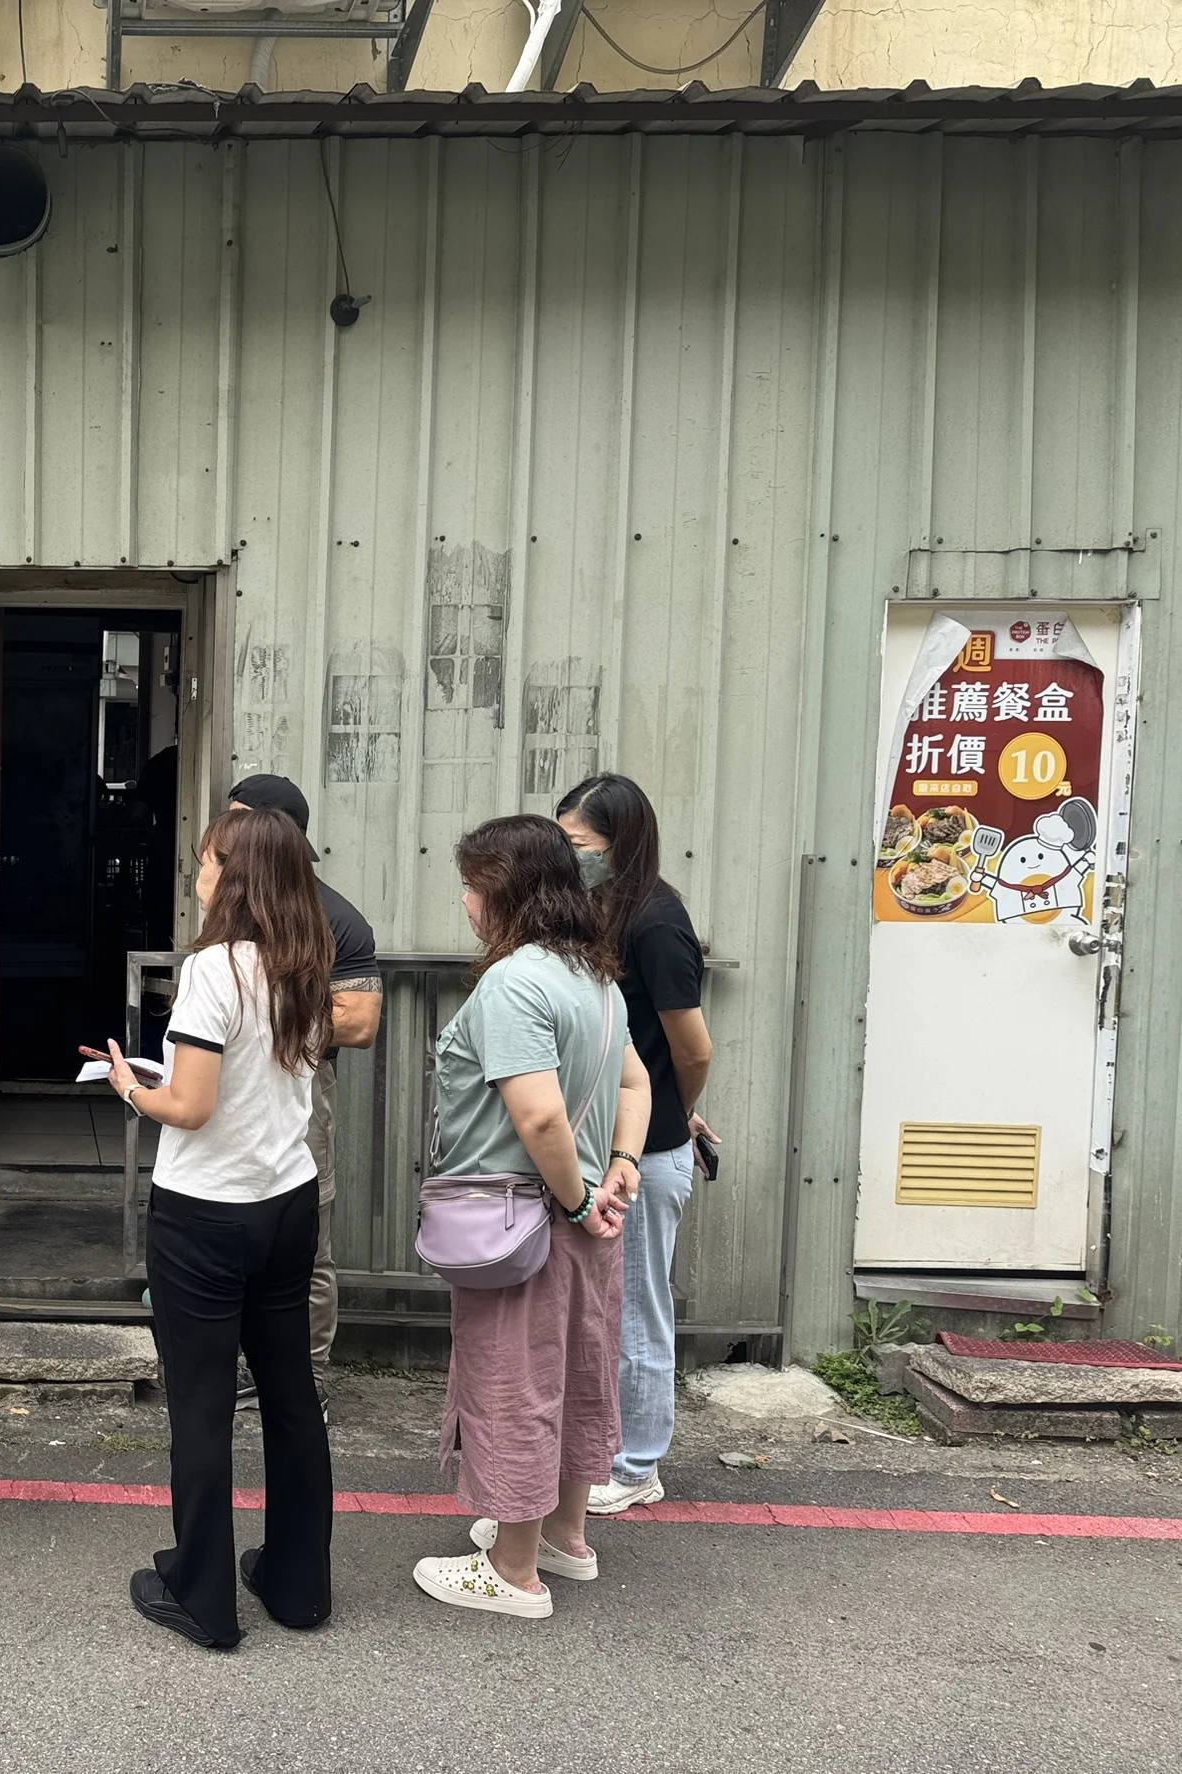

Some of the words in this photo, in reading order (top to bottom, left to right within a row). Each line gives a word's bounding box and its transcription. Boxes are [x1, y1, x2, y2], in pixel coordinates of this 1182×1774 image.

[905, 733, 986, 775] 折價
[1010, 749, 1057, 784] 10
[1055, 780, 1072, 797] 元
